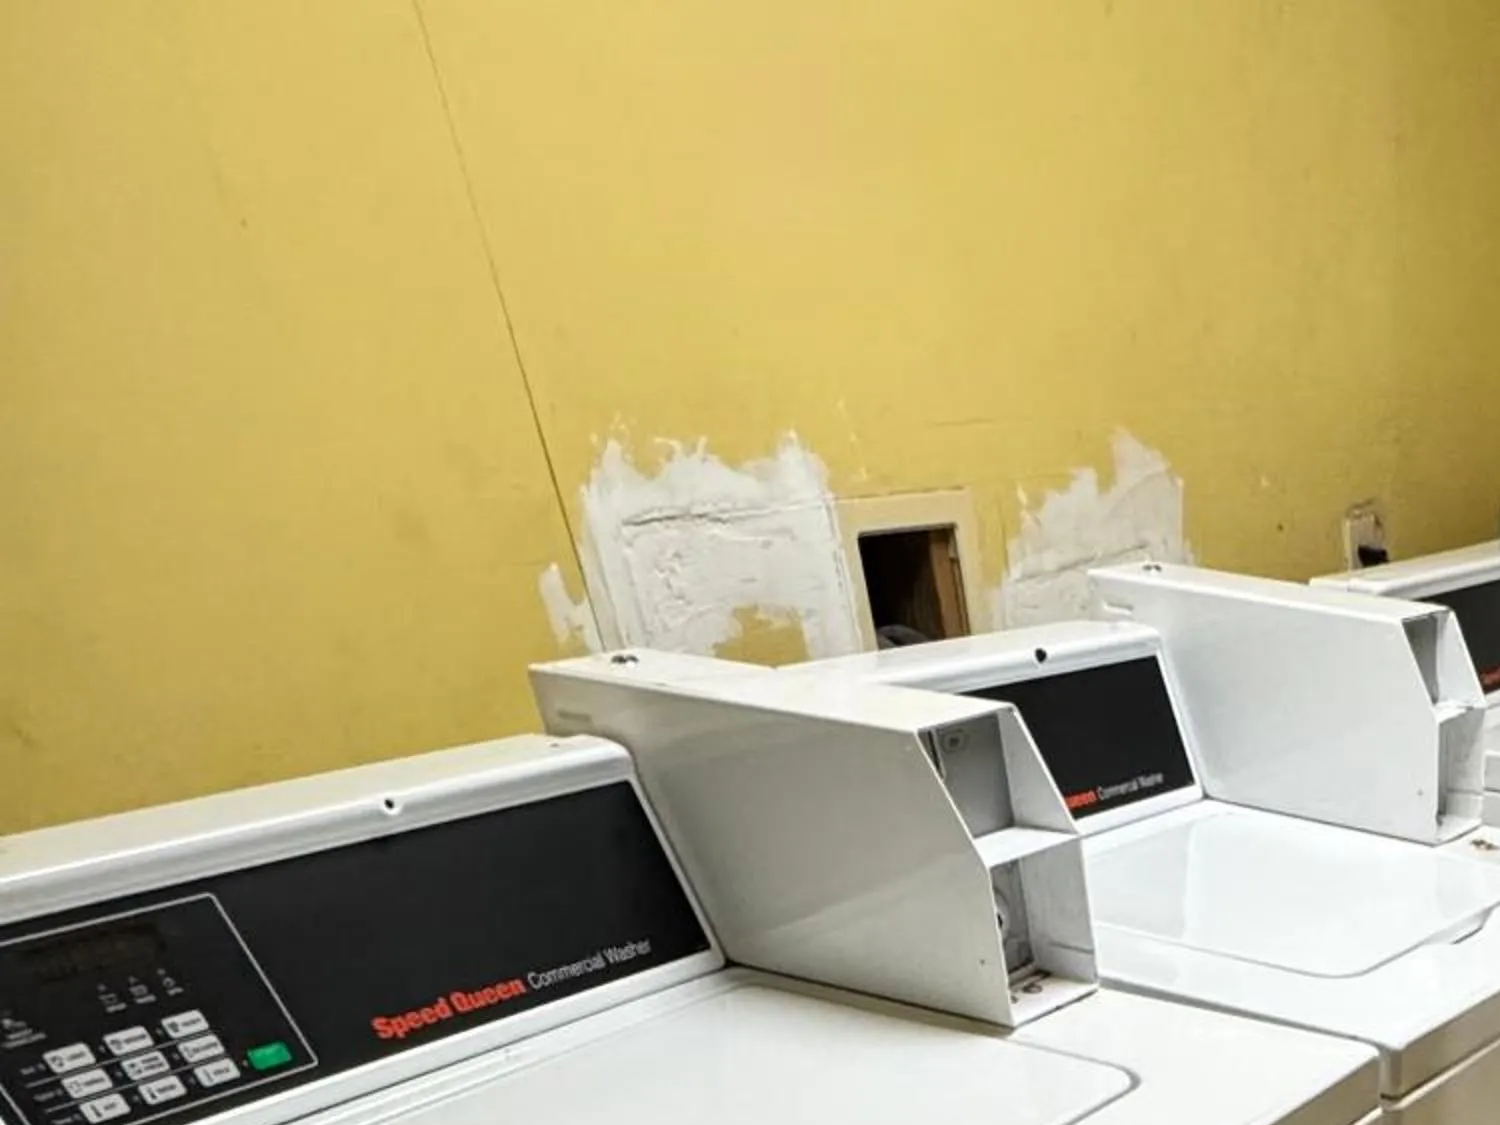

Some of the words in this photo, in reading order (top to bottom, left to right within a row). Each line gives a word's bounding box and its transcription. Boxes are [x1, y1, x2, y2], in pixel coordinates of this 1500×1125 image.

[371, 998, 453, 1039] Speed
[449, 979, 527, 1013] Queen
[527, 954, 606, 989] Commercial
[603, 939, 651, 964] Washer
